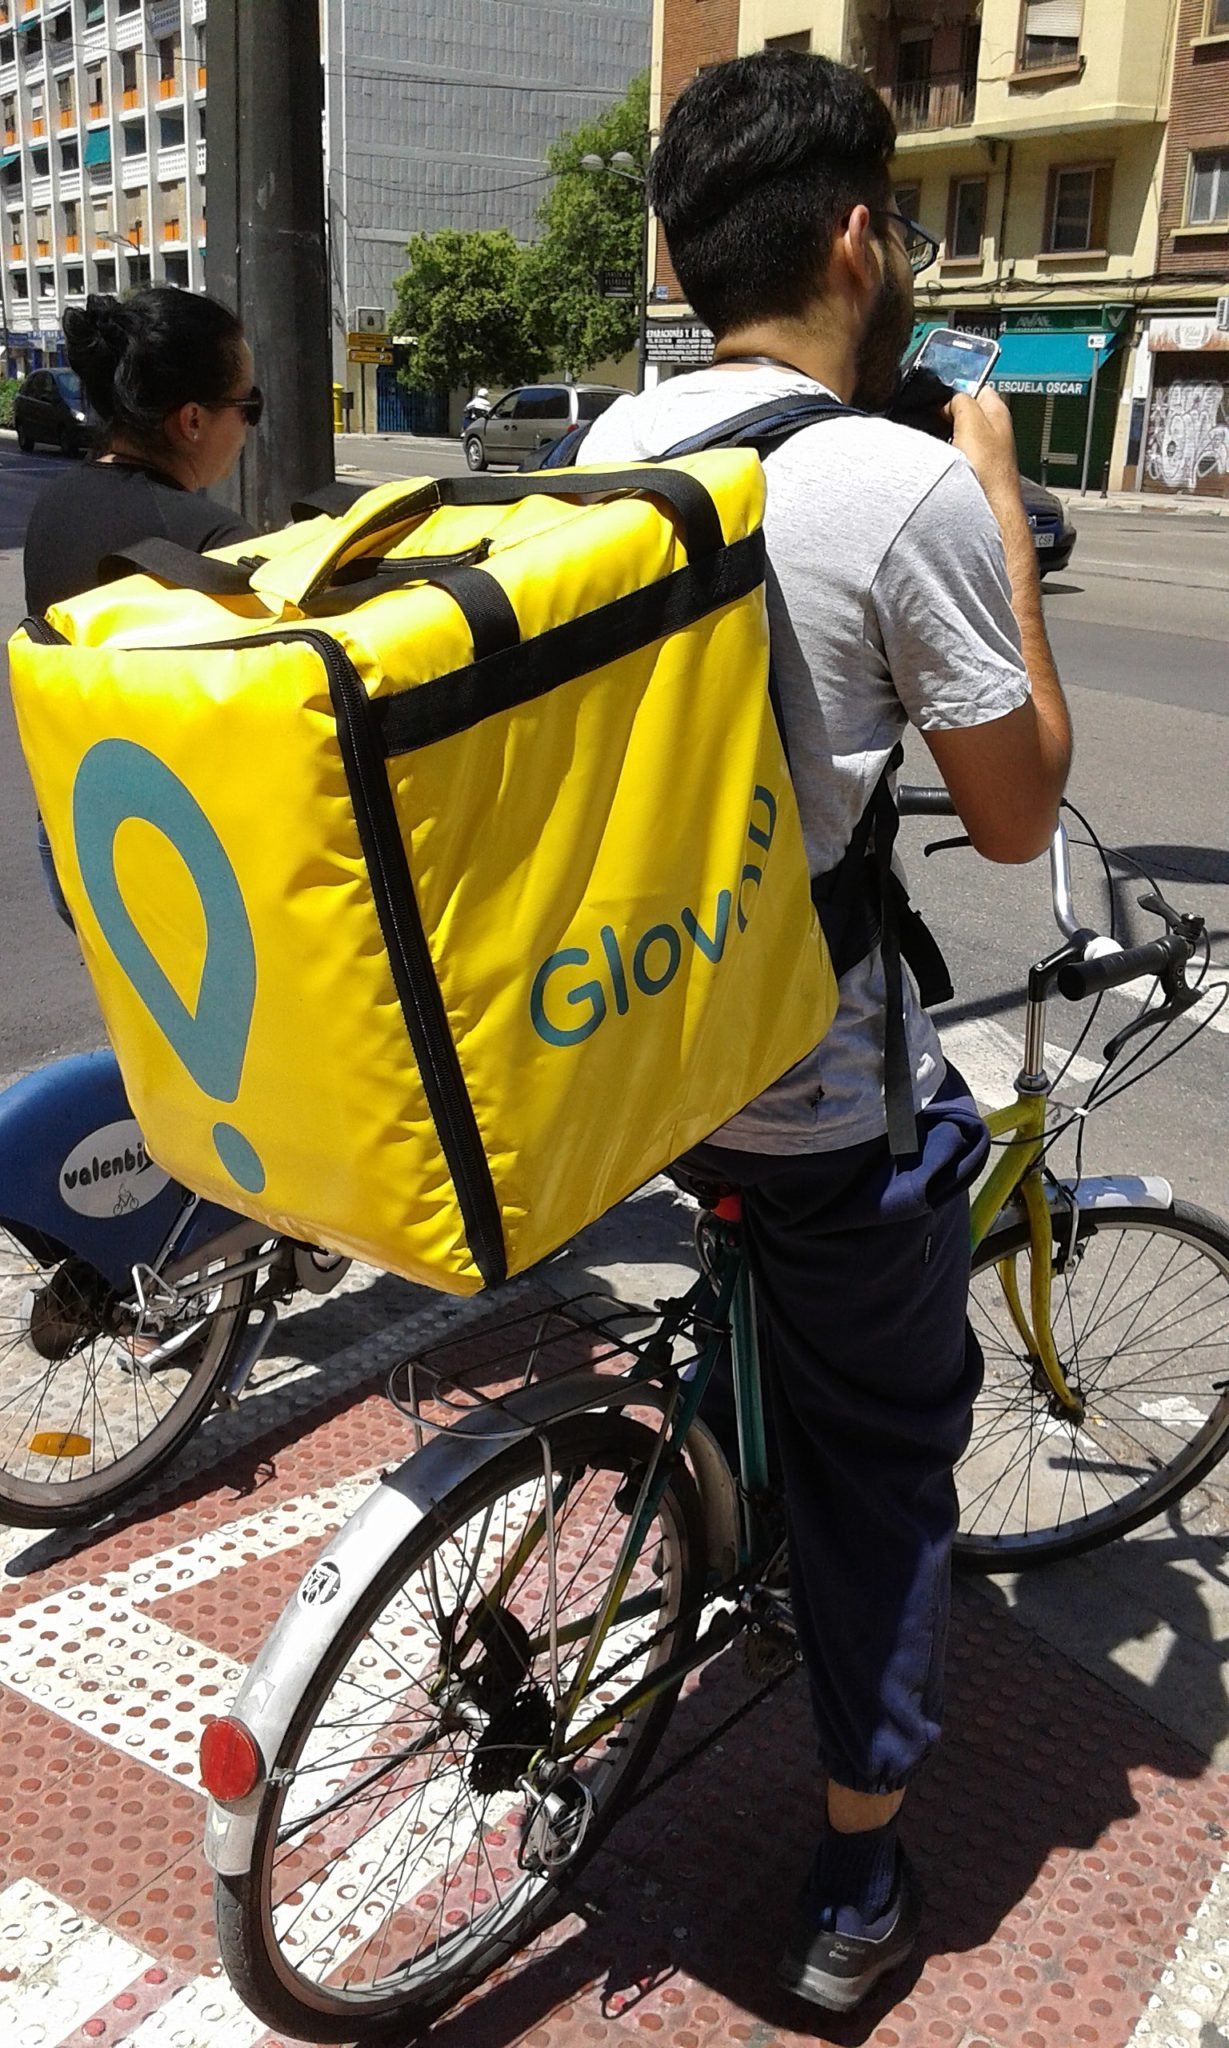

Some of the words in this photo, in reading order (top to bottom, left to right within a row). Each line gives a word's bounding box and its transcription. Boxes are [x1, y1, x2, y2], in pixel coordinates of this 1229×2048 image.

[998, 381, 1044, 393] ESCUELA
[1046, 381, 1083, 394] OSCAR
[63, 1141, 146, 1190] valenbi
